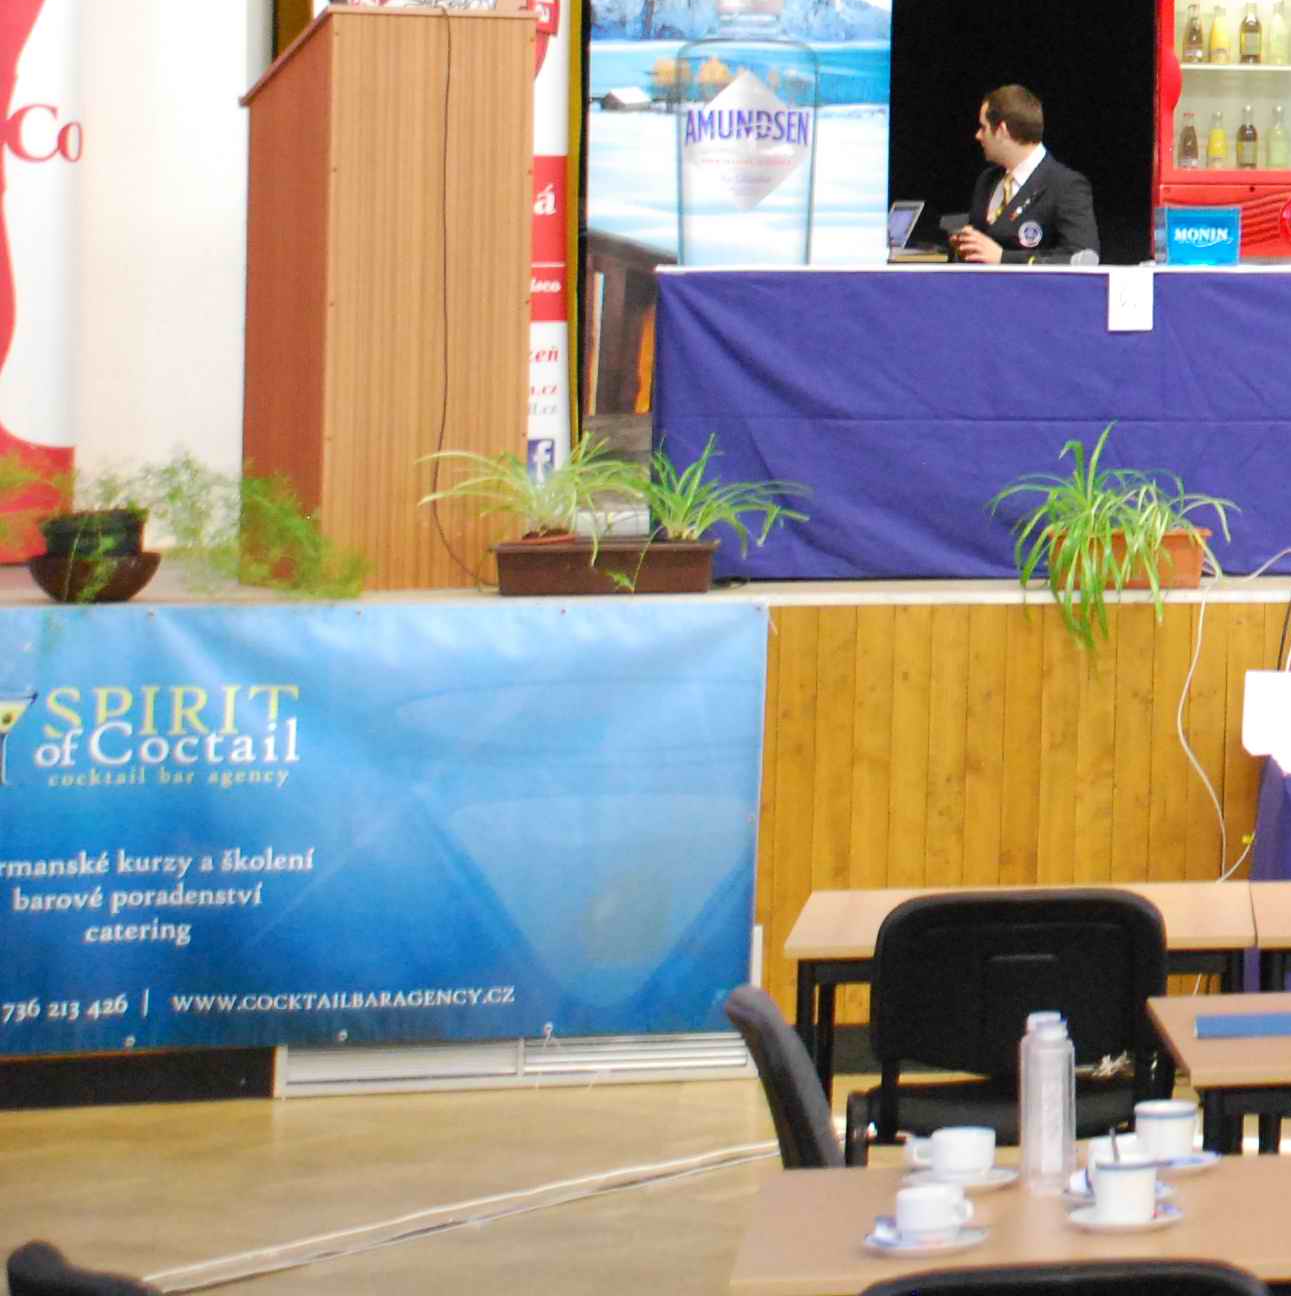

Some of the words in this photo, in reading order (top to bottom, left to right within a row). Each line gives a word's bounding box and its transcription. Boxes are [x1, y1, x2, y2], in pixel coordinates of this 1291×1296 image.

[685, 109, 809, 146] AMUNDSEN
[1174, 226, 1229, 243] MONIN
[42, 684, 300, 738] SPIRIT
[34, 727, 83, 767] of
[88, 717, 300, 766] Coctail
[49, 767, 145, 787] cocktail
[159, 765, 195, 784] bar
[208, 767, 289, 789] agency
[117, 849, 192, 879] kurzy
[200, 855, 214, 873] a
[221, 846, 316, 873] školení
[12, 885, 103, 912] barové
[110, 881, 264, 915] poradenství
[83, 918, 192, 946] catering
[1, 998, 41, 1024] 736
[48, 1002, 81, 1020] 213
[86, 993, 129, 1020] 426
[171, 985, 516, 1013] WWW.COCKTAILBARAGENCY.CZ
